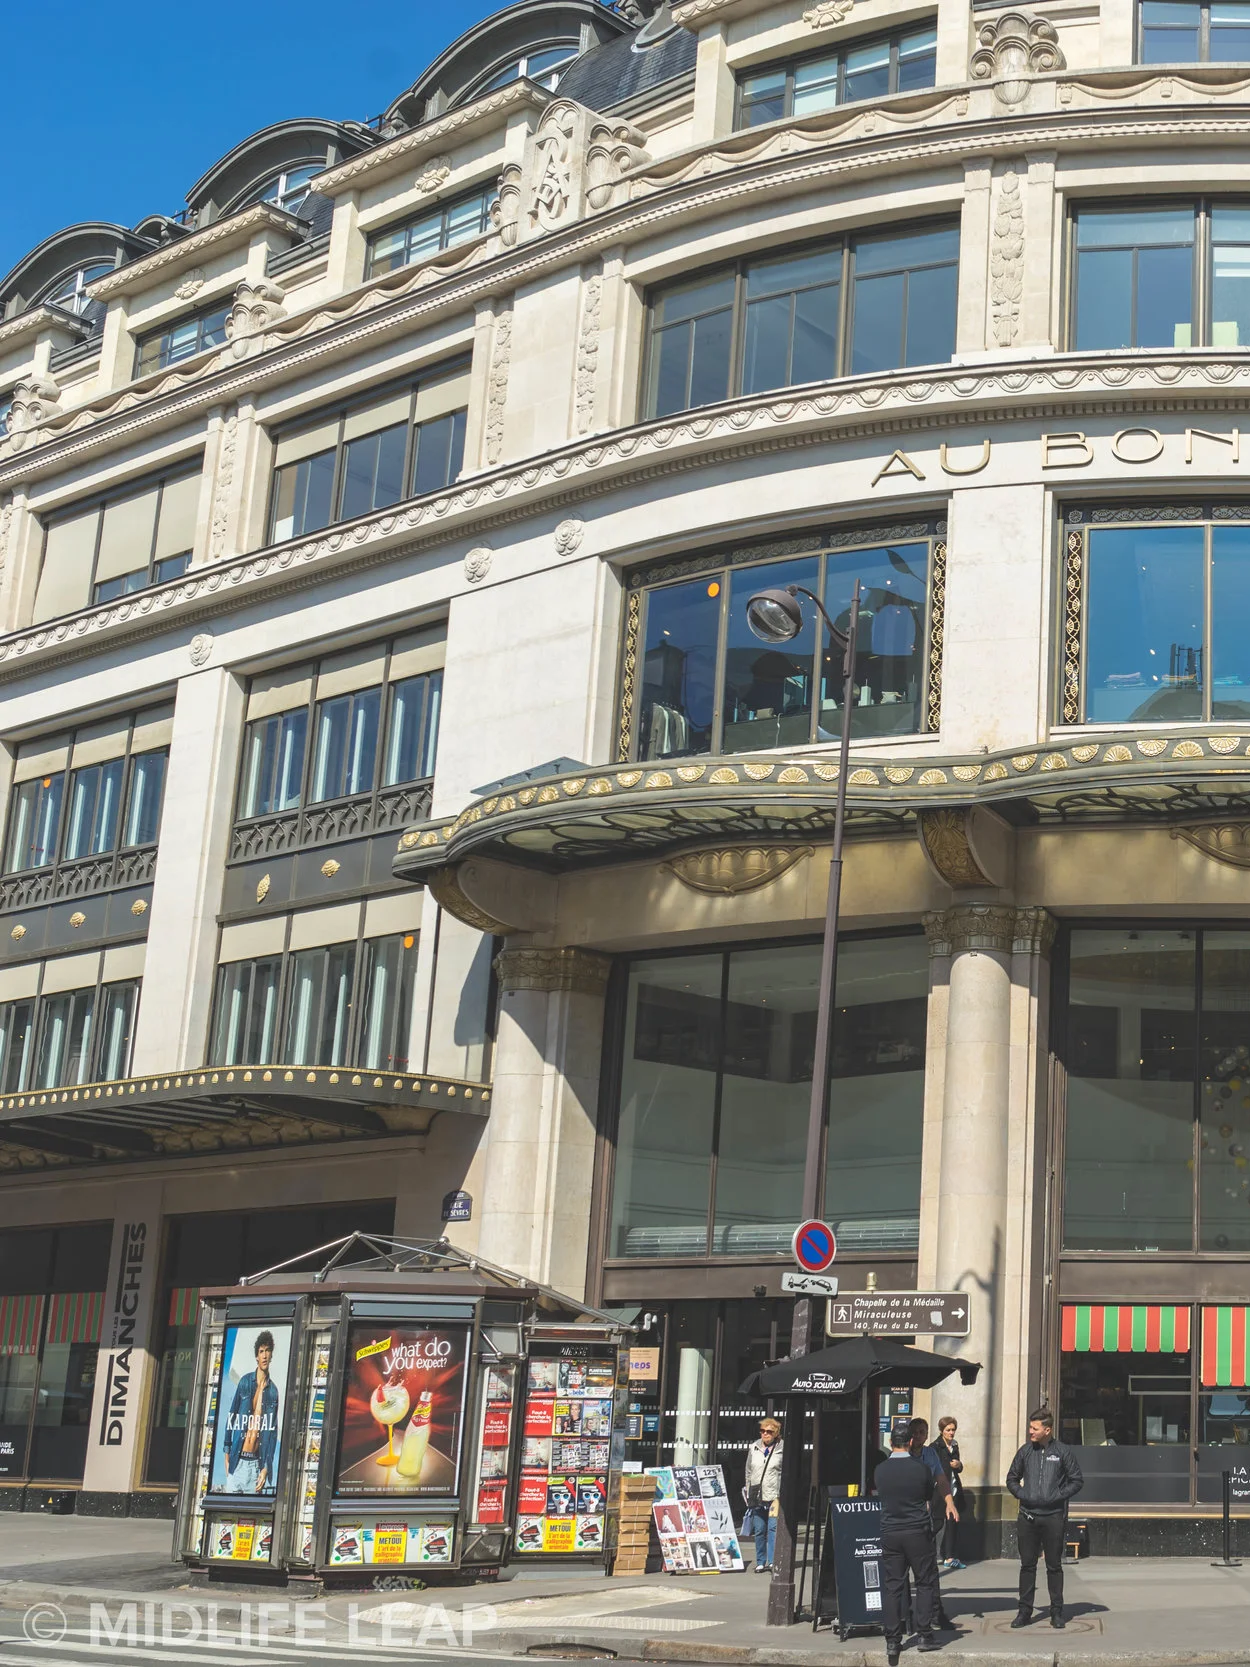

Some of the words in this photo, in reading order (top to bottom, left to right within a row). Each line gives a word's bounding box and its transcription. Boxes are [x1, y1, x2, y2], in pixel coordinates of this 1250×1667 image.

[870, 437, 991, 489] AU
[1040, 426, 1239, 468] BON
[854, 1298, 887, 1309] Chapelle
[890, 1298, 900, 1307] de
[902, 1298, 910, 1307] la
[912, 1297, 945, 1307] Médaille
[854, 1310, 912, 1319] Miraculeuse
[873, 1322, 887, 1330] Rue
[891, 1322, 901, 1330] du
[904, 1322, 919, 1330] Bac
[106, 1221, 147, 1446] DIMANCHES
[391, 1341, 422, 1358] what
[425, 1336, 451, 1357] do
[382, 1356, 414, 1375] you
[415, 1357, 448, 1371] expect?
[226, 1412, 276, 1432] KAPORAL
[1233, 1466, 1247, 1475] LA
[835, 1501, 882, 1513] VOITURI
[379, 1537, 402, 1545] METOUI
